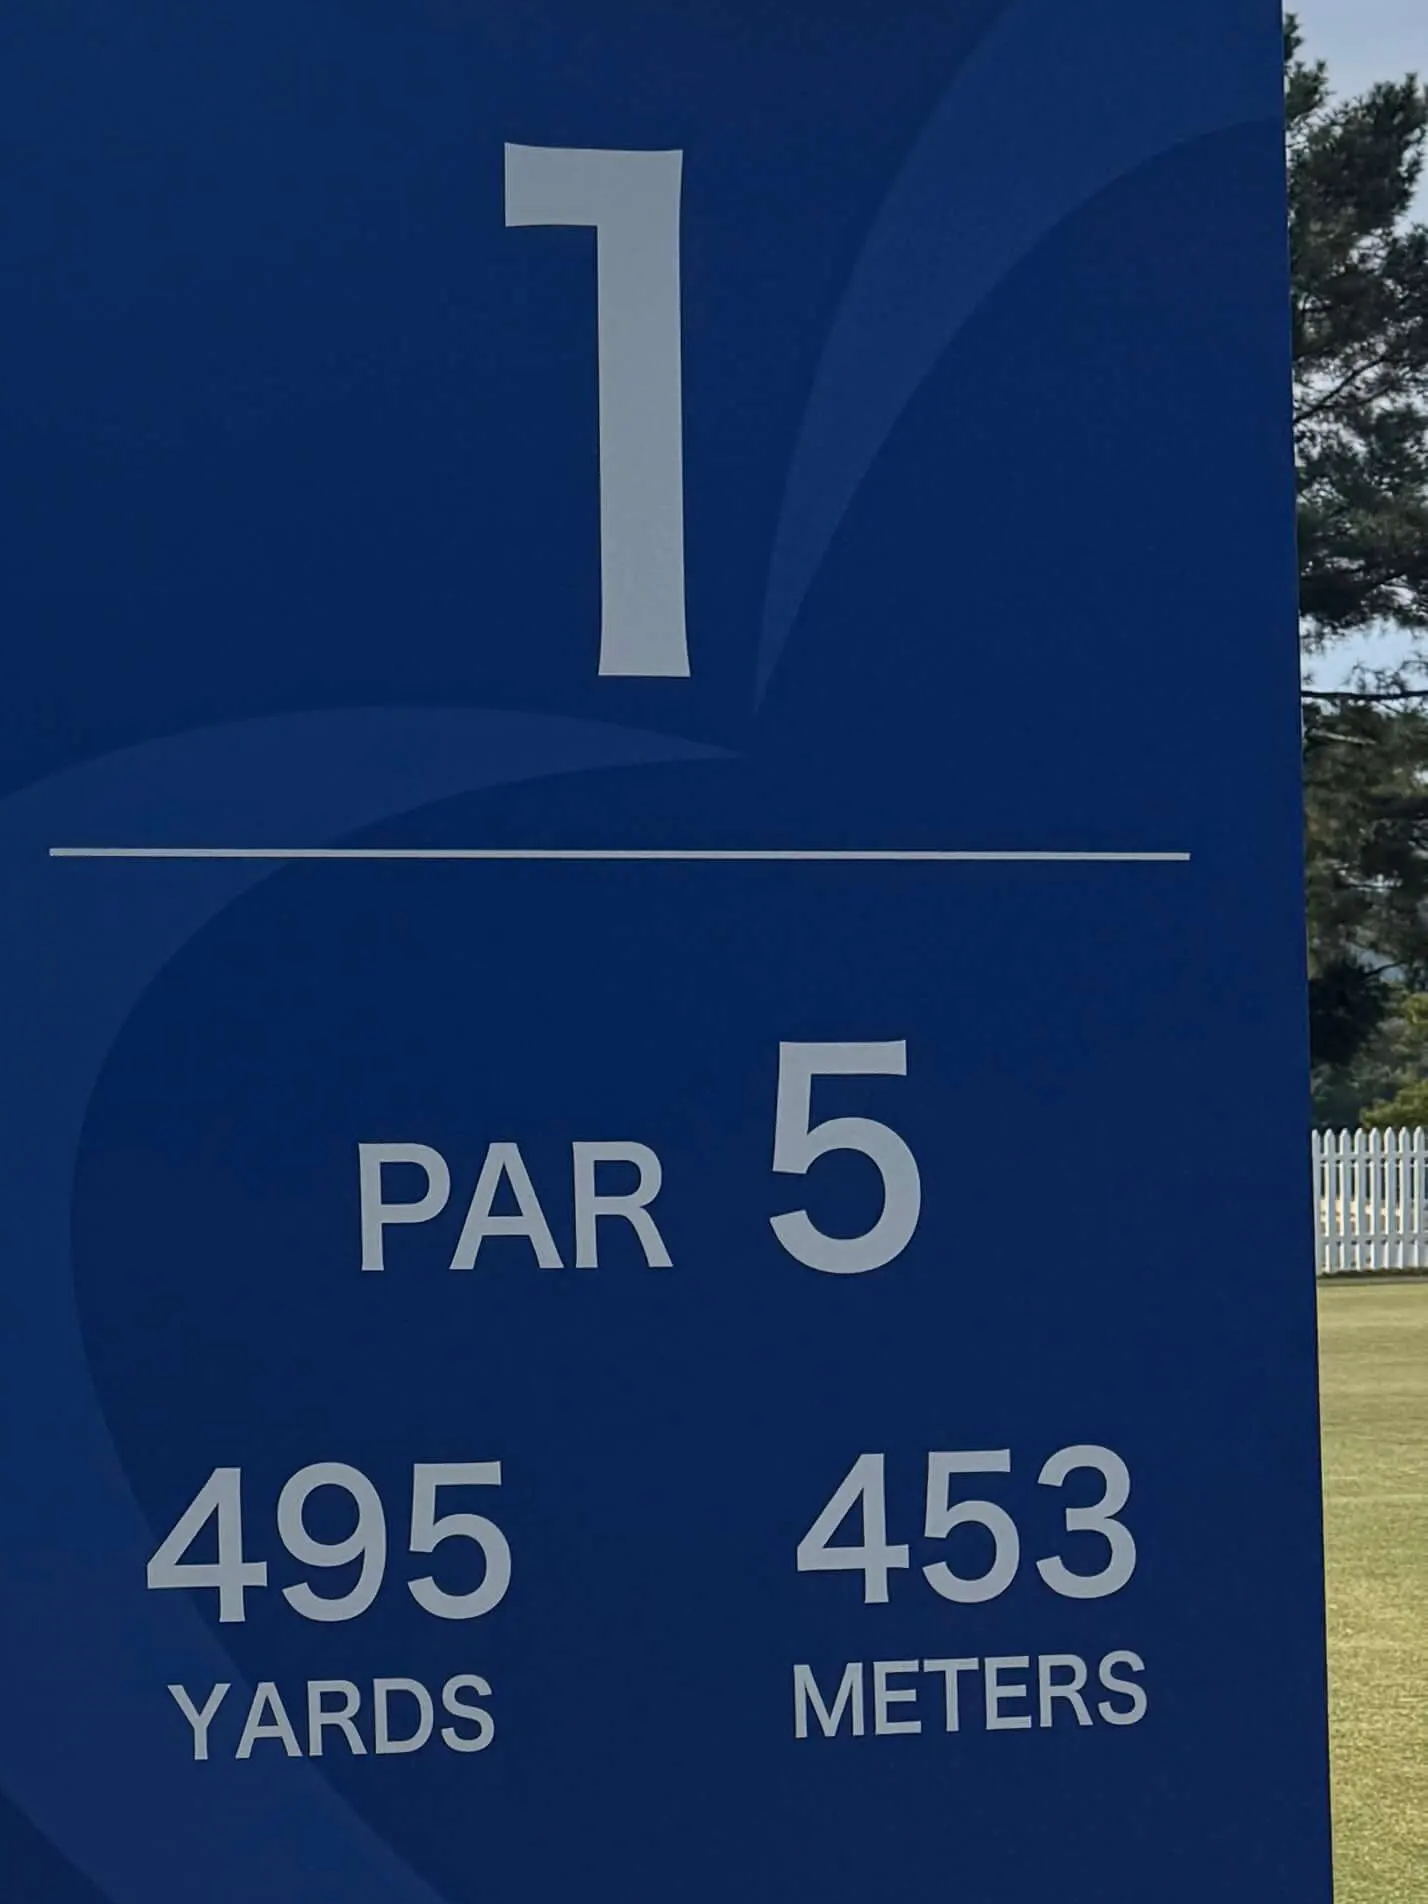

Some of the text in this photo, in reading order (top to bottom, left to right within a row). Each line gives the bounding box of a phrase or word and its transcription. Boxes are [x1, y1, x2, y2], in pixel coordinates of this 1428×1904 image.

[504, 142, 690, 677] 1
[358, 1039, 921, 1274] PAR 5
[146, 1460, 512, 1622] 495
[796, 1444, 1137, 1604] 453
[167, 1673, 495, 1761] YARDS
[792, 1649, 1148, 1740] METERS
